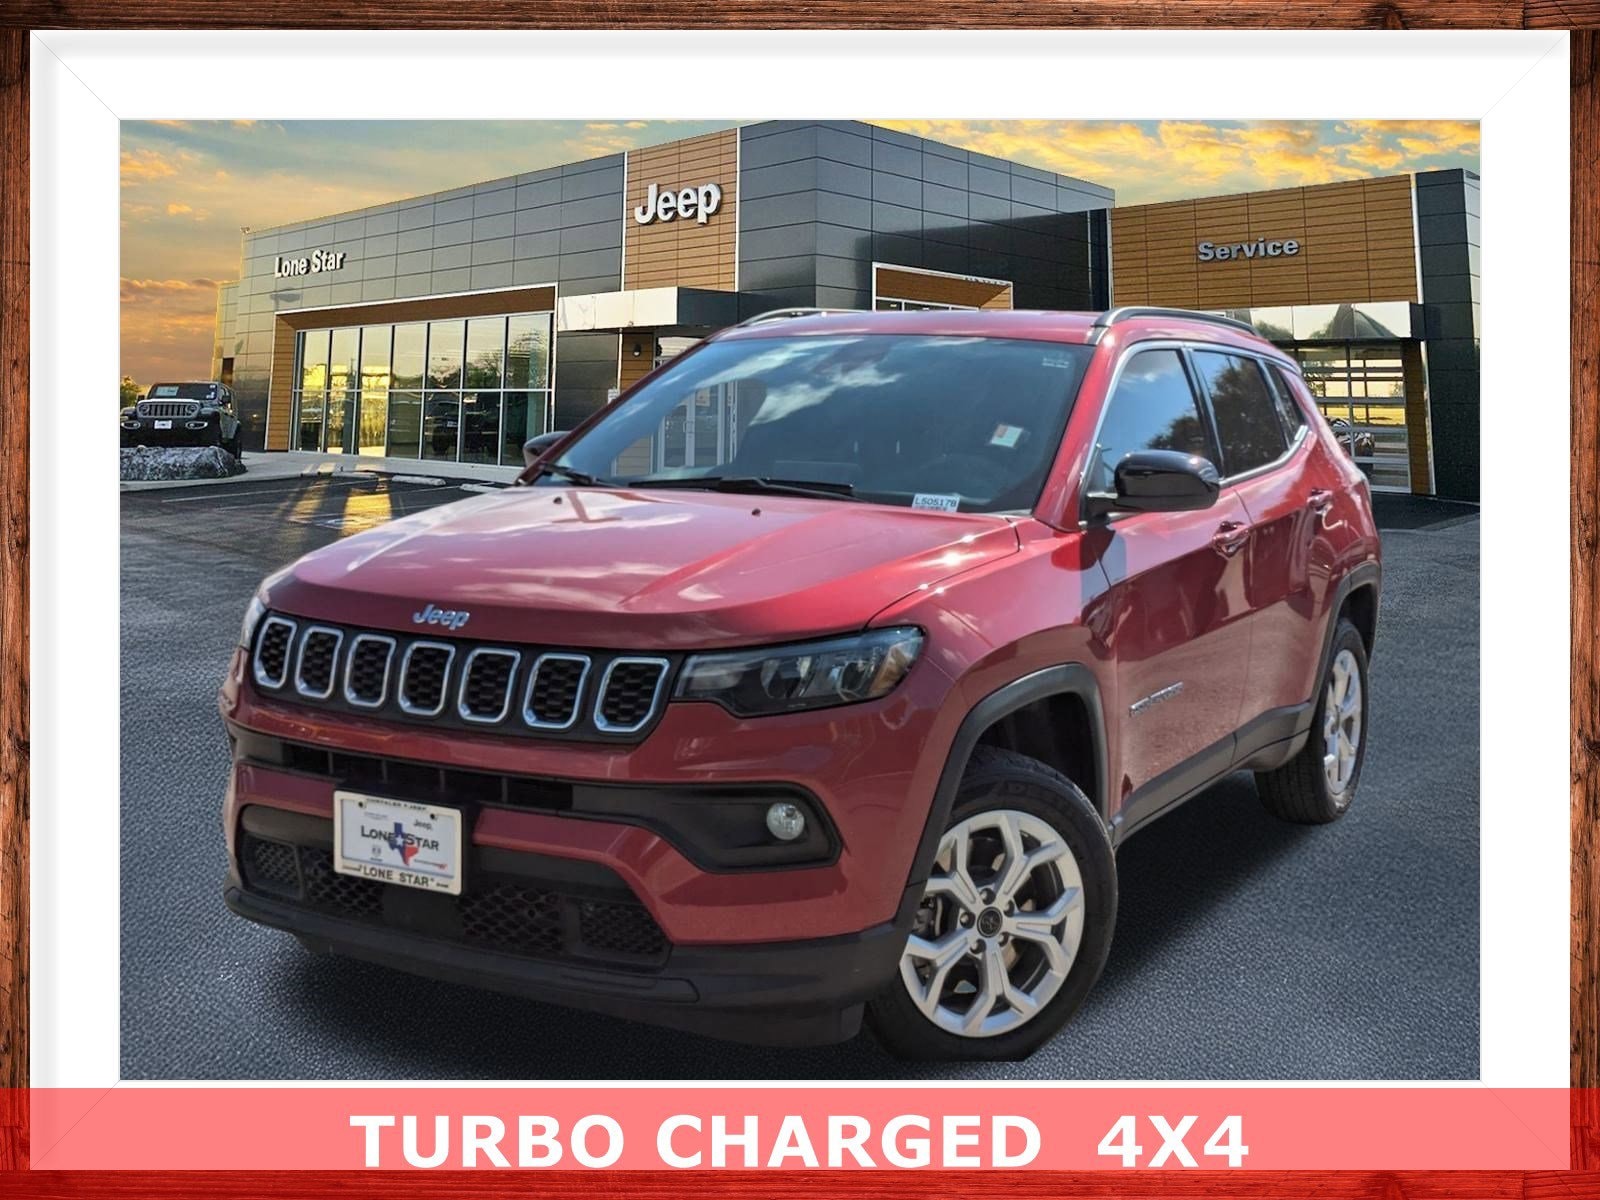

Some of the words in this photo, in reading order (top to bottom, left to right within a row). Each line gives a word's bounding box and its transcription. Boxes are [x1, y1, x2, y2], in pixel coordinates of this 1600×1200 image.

[634, 183, 721, 224] Jeep
[1198, 237, 1299, 261] Service
[274, 256, 309, 278] Lone
[312, 249, 346, 273] Star
[412, 603, 470, 631] Jeep
[360, 824, 396, 842] LONE
[404, 832, 440, 852] STAR
